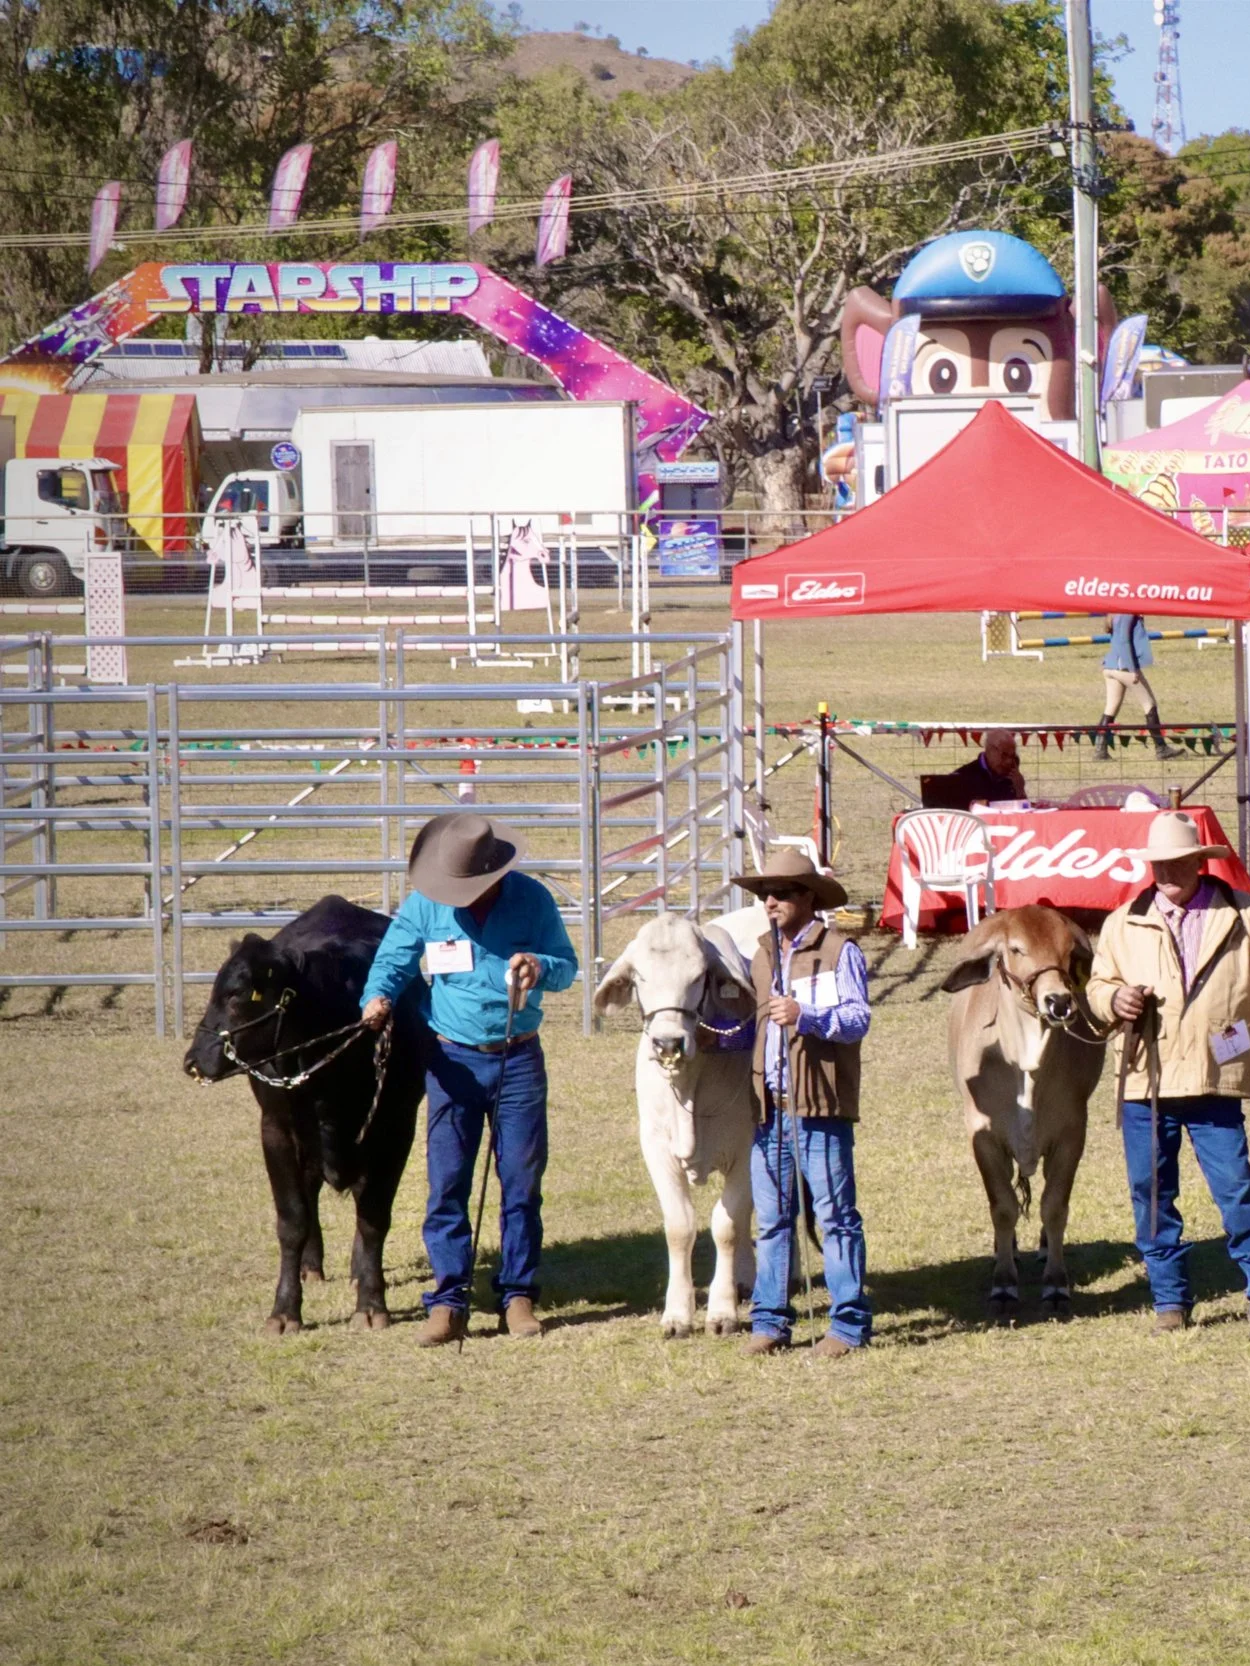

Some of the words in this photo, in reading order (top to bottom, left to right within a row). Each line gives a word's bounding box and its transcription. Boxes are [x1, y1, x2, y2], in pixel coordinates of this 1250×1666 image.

[146, 264, 480, 312] STARSHIP
[1204, 453, 1248, 469] TATO
[791, 580, 859, 601] Elders
[1064, 576, 1213, 601] elders.com.au
